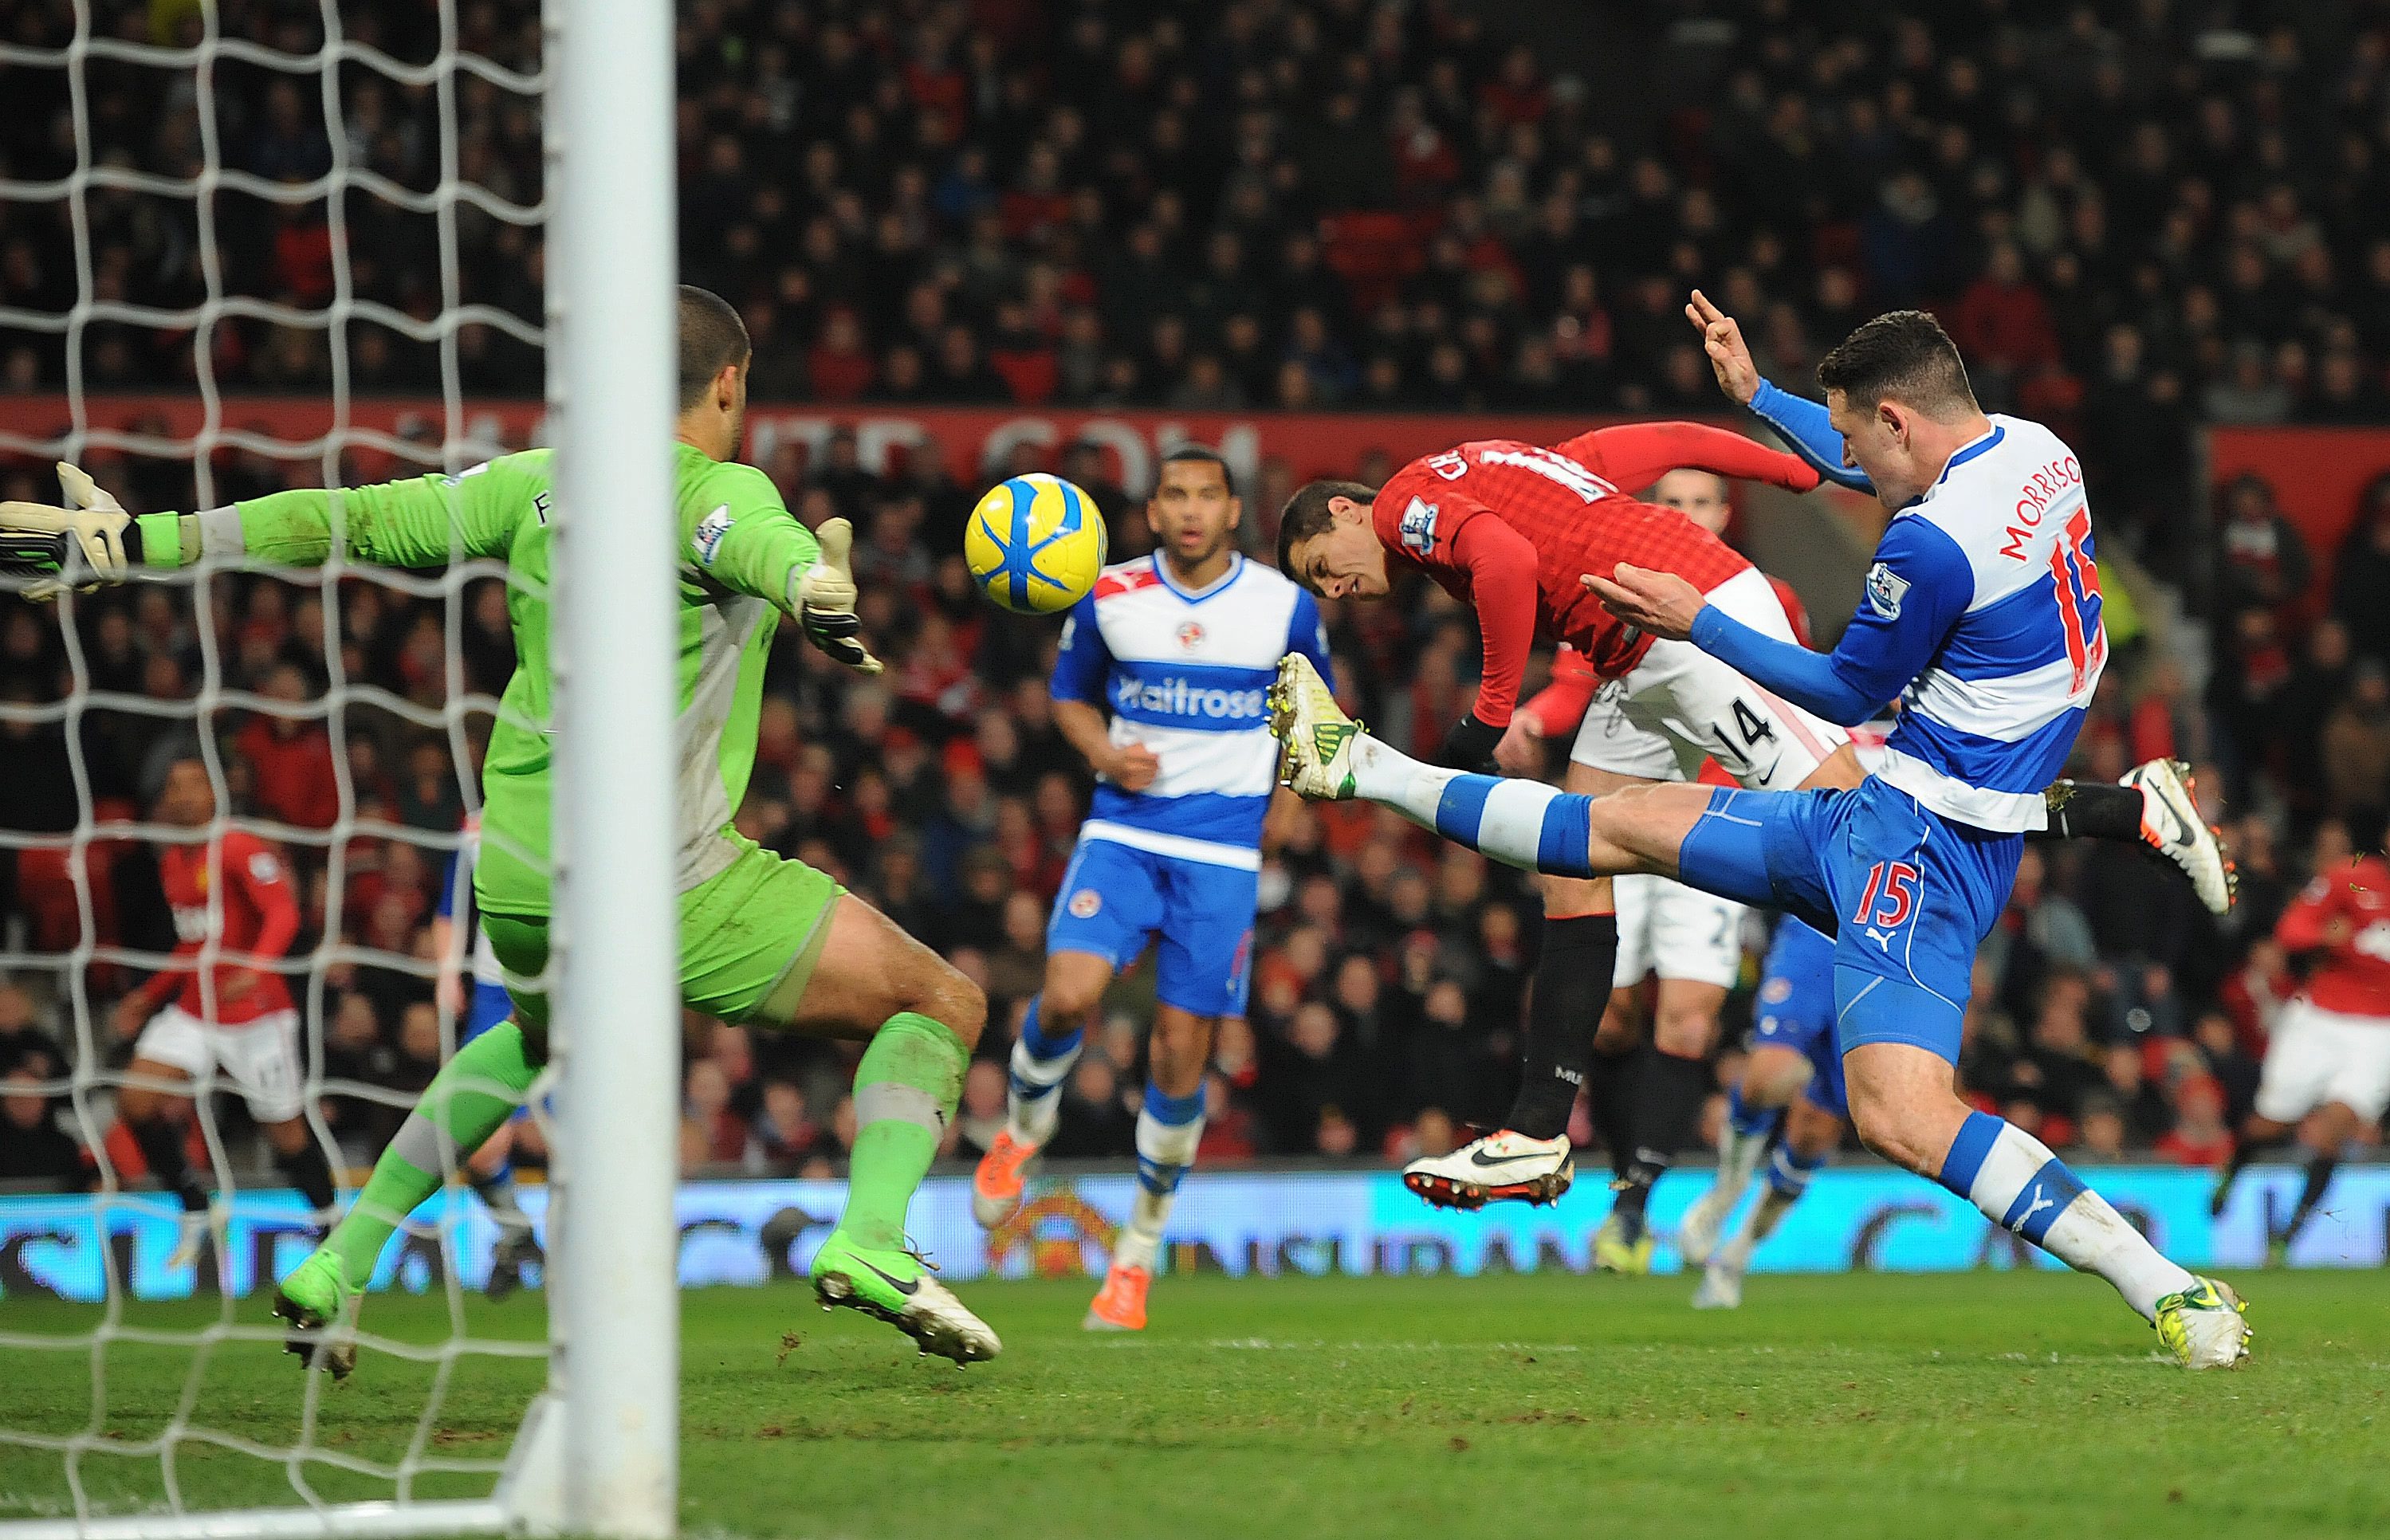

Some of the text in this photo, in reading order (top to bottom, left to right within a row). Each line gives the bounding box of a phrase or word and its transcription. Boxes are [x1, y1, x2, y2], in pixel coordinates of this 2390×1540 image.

[1999, 456, 2081, 563] MORRISO
[1712, 697, 1779, 770] 14
[1853, 861, 1918, 928] 15
